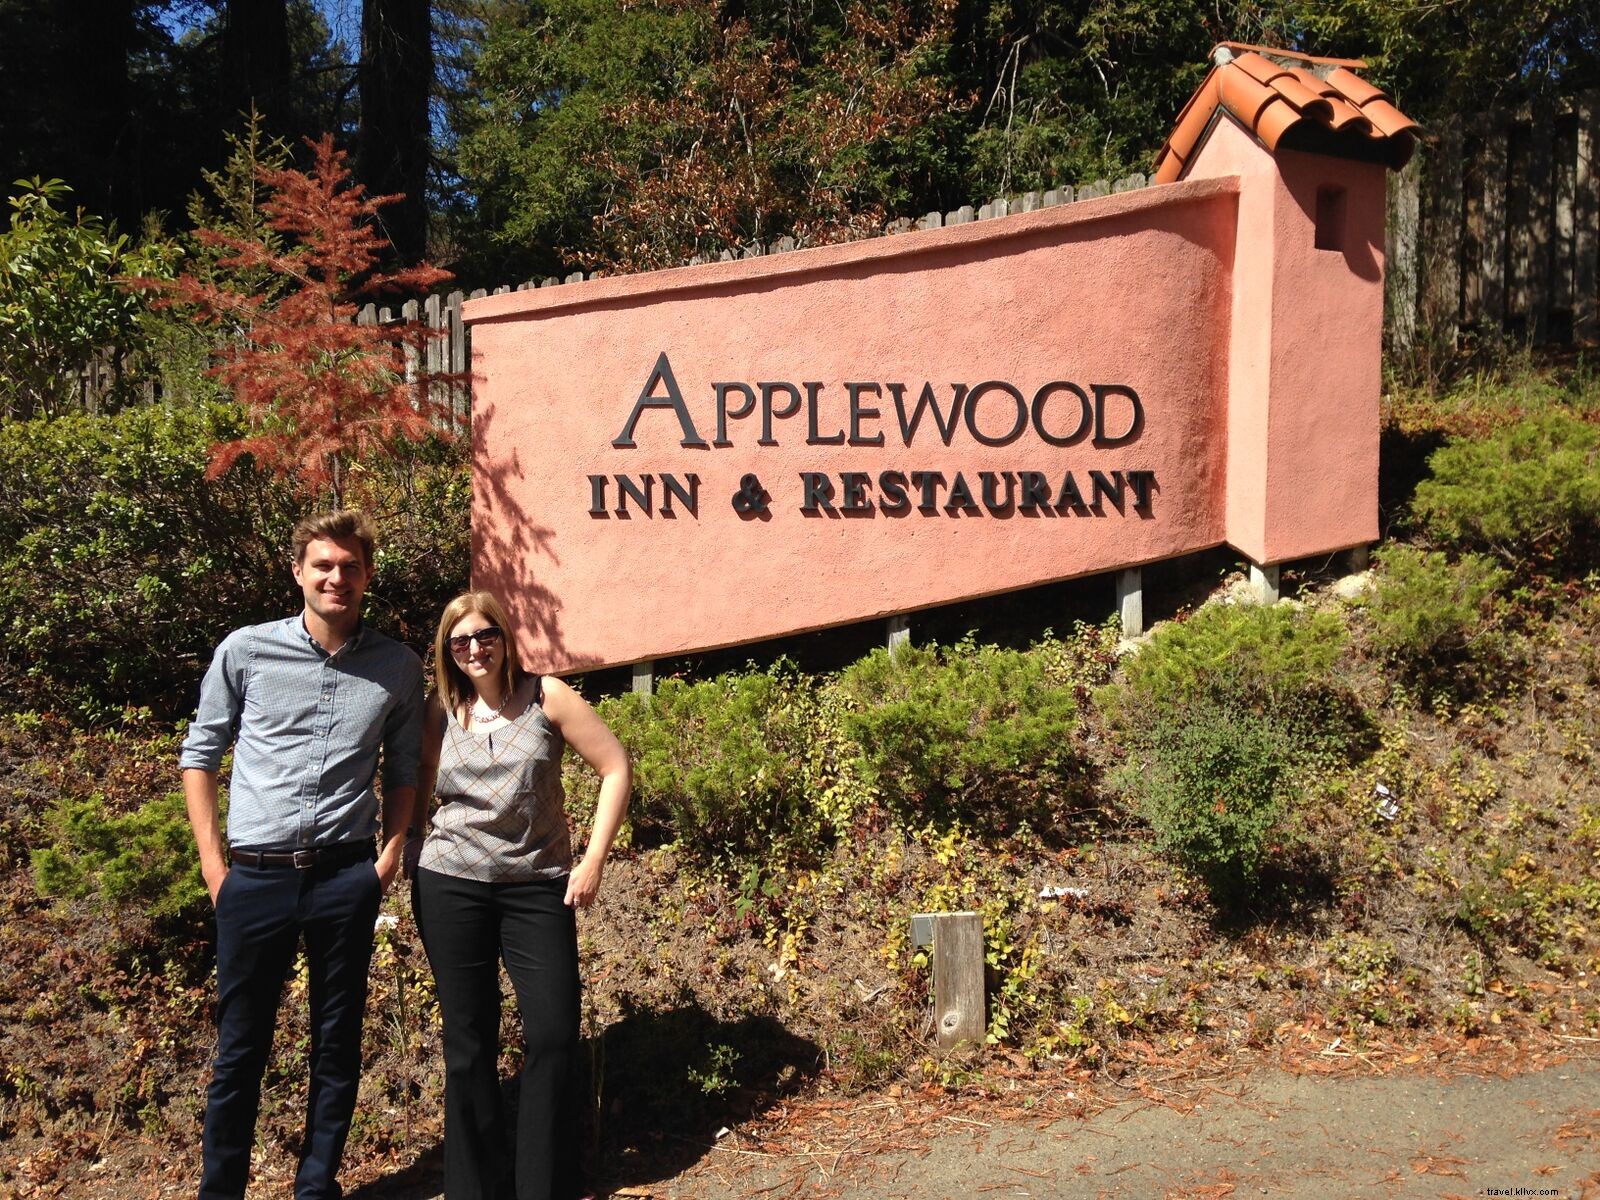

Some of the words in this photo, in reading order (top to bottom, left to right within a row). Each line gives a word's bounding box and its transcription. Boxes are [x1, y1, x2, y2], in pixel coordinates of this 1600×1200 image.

[611, 351, 1144, 450] APPLEWOOD
[587, 474, 700, 519] INN
[731, 472, 771, 521] &
[799, 470, 1157, 518] RESTAURANT
